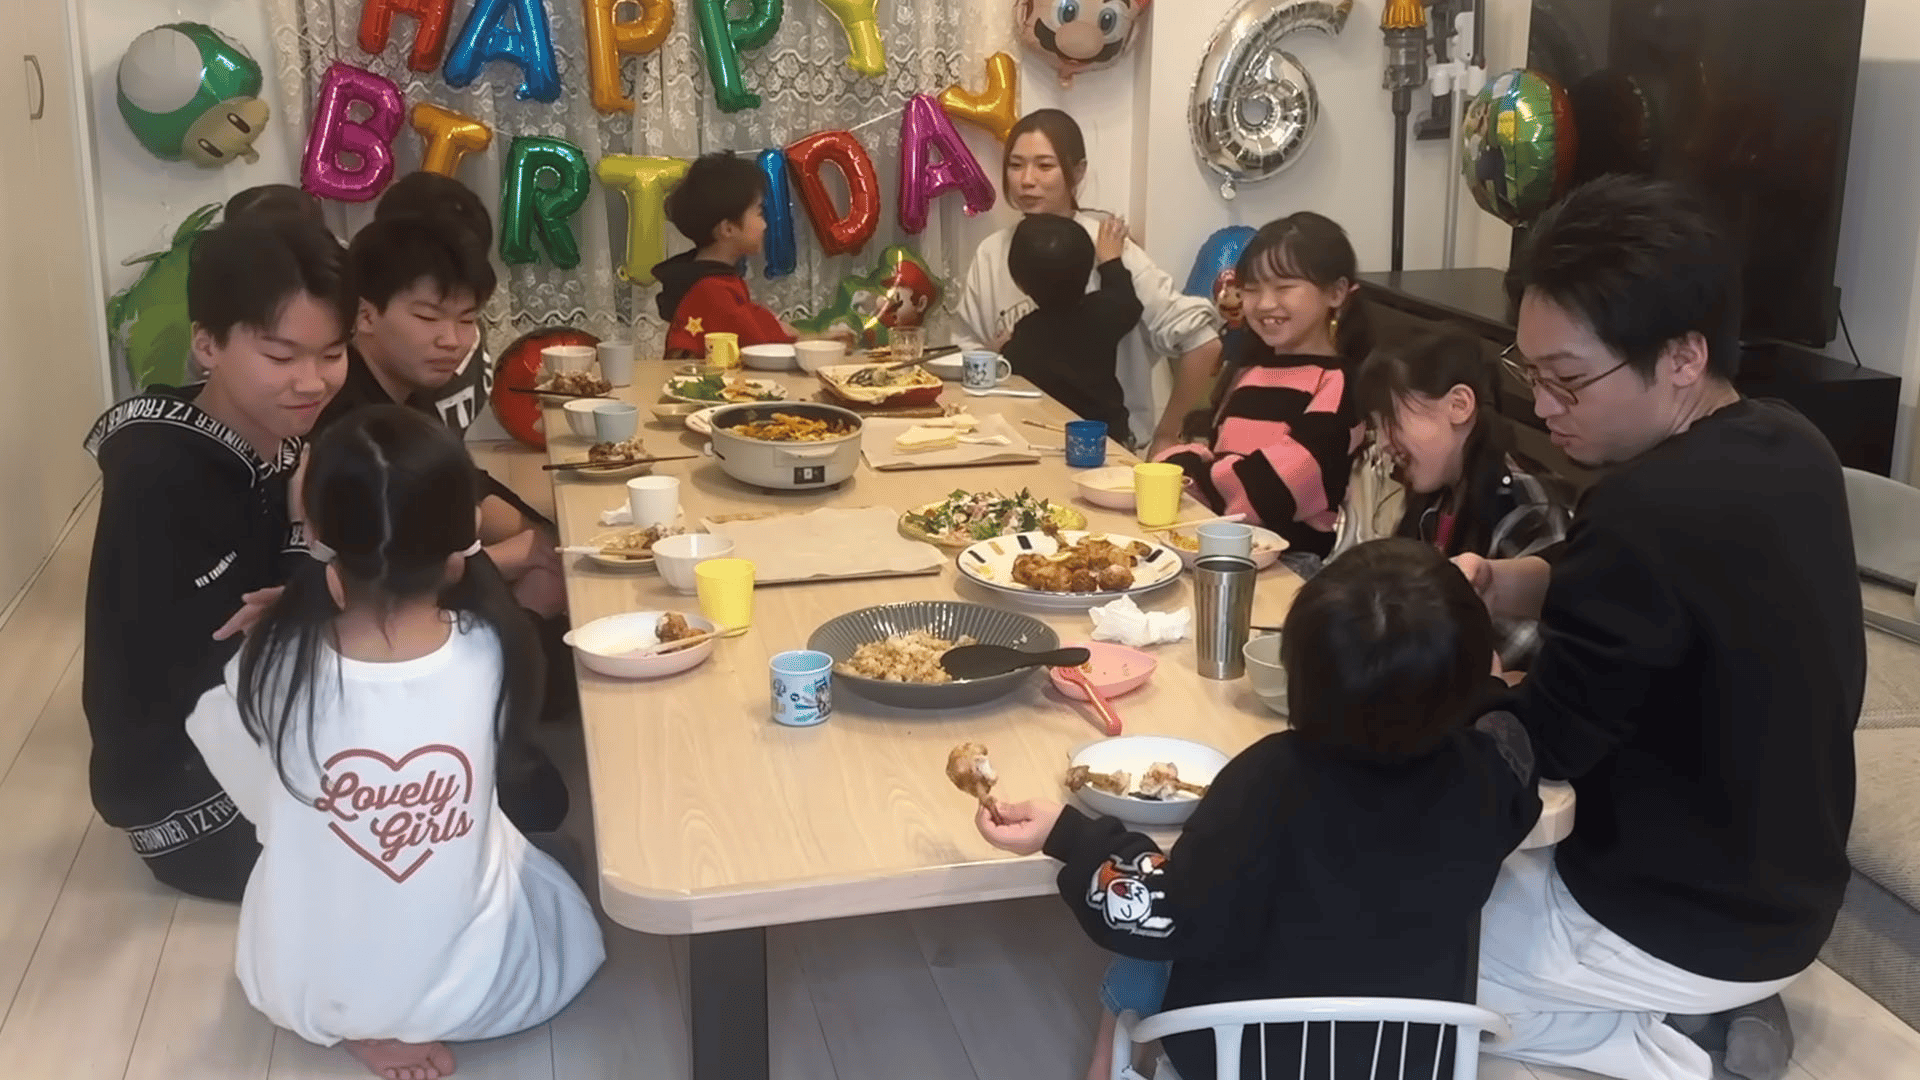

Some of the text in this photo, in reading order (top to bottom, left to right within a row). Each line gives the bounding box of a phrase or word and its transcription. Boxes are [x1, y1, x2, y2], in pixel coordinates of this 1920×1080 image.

[356, 0, 887, 113] HAPPY
[1187, 0, 1354, 183] 6
[314, 770, 460, 822] Lovely
[369, 806, 475, 862] Girls
